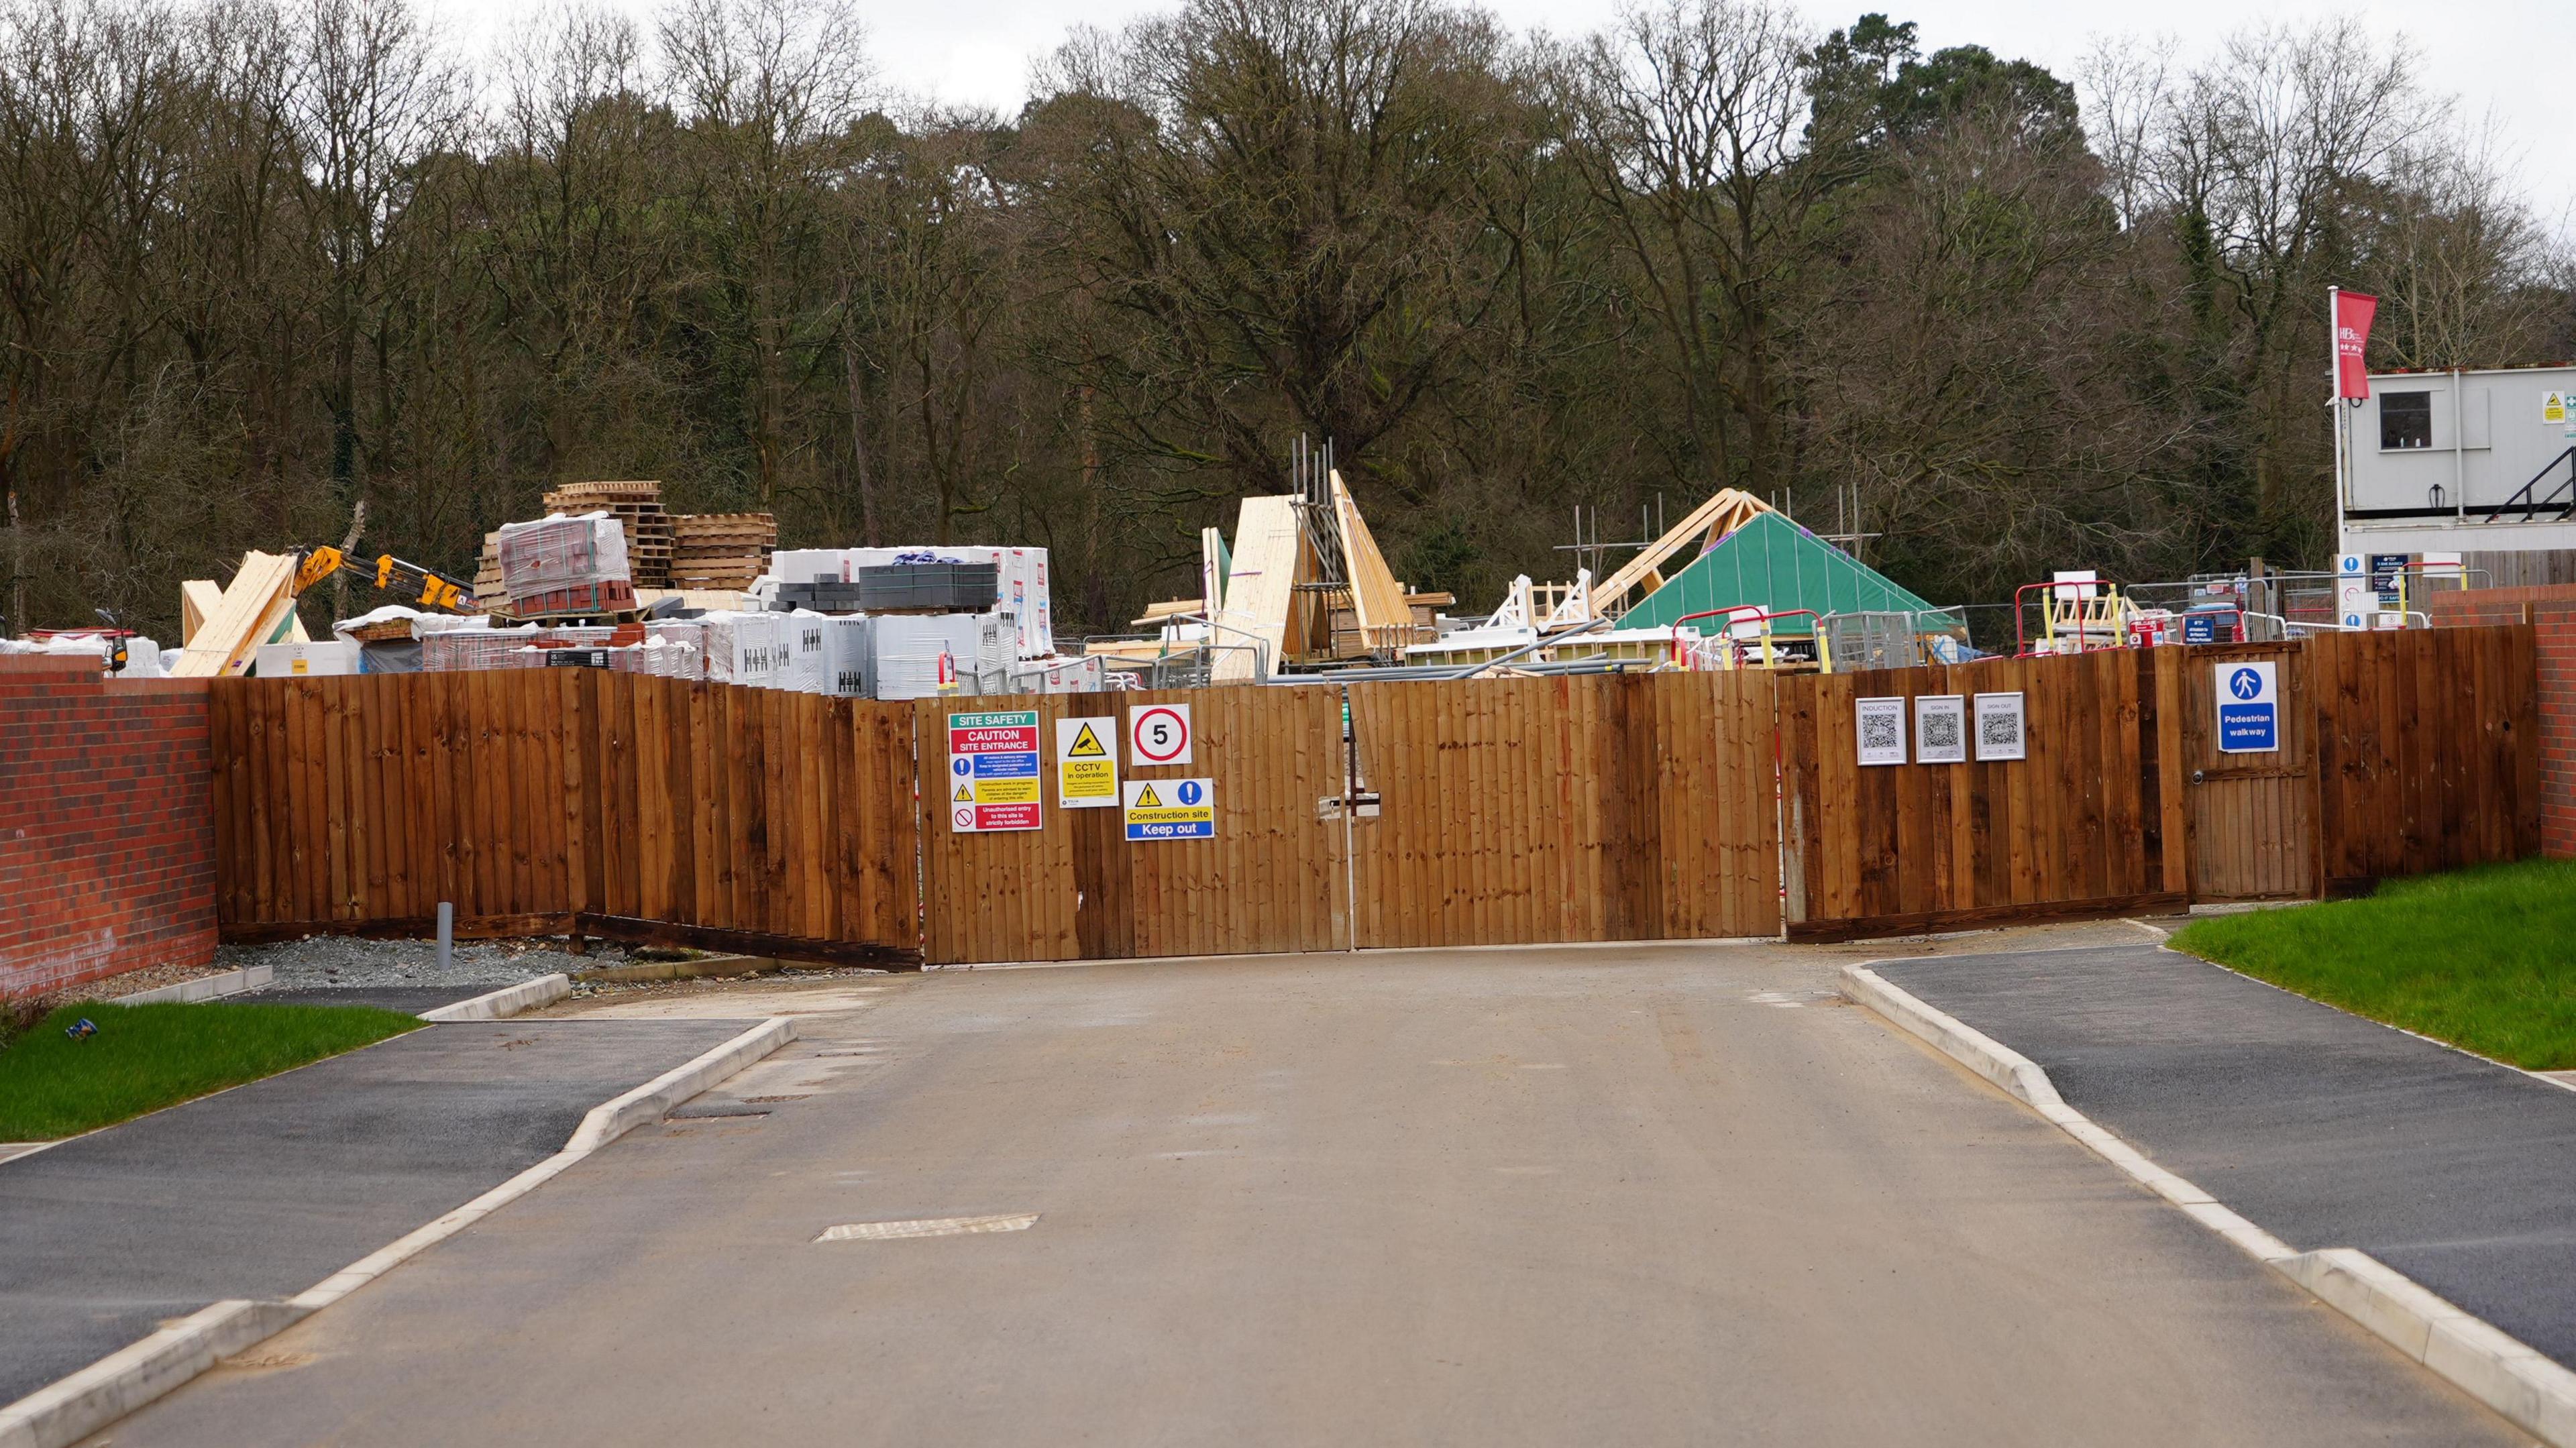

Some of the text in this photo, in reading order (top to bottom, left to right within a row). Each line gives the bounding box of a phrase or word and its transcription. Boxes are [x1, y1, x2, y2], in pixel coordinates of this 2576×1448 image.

[959, 714, 1027, 726] SITE SAFETY
[2224, 715, 2270, 723] Pedestrian
[968, 730, 1019, 741] CAUTION
[1154, 724, 1168, 744] 5
[2229, 728, 2266, 737] walkway
[960, 741, 1028, 751] SITE ENTRANCE
[1075, 763, 1101, 771] CCTV
[1130, 811, 1189, 820] Construction
[1142, 823, 1197, 836] Keep out
